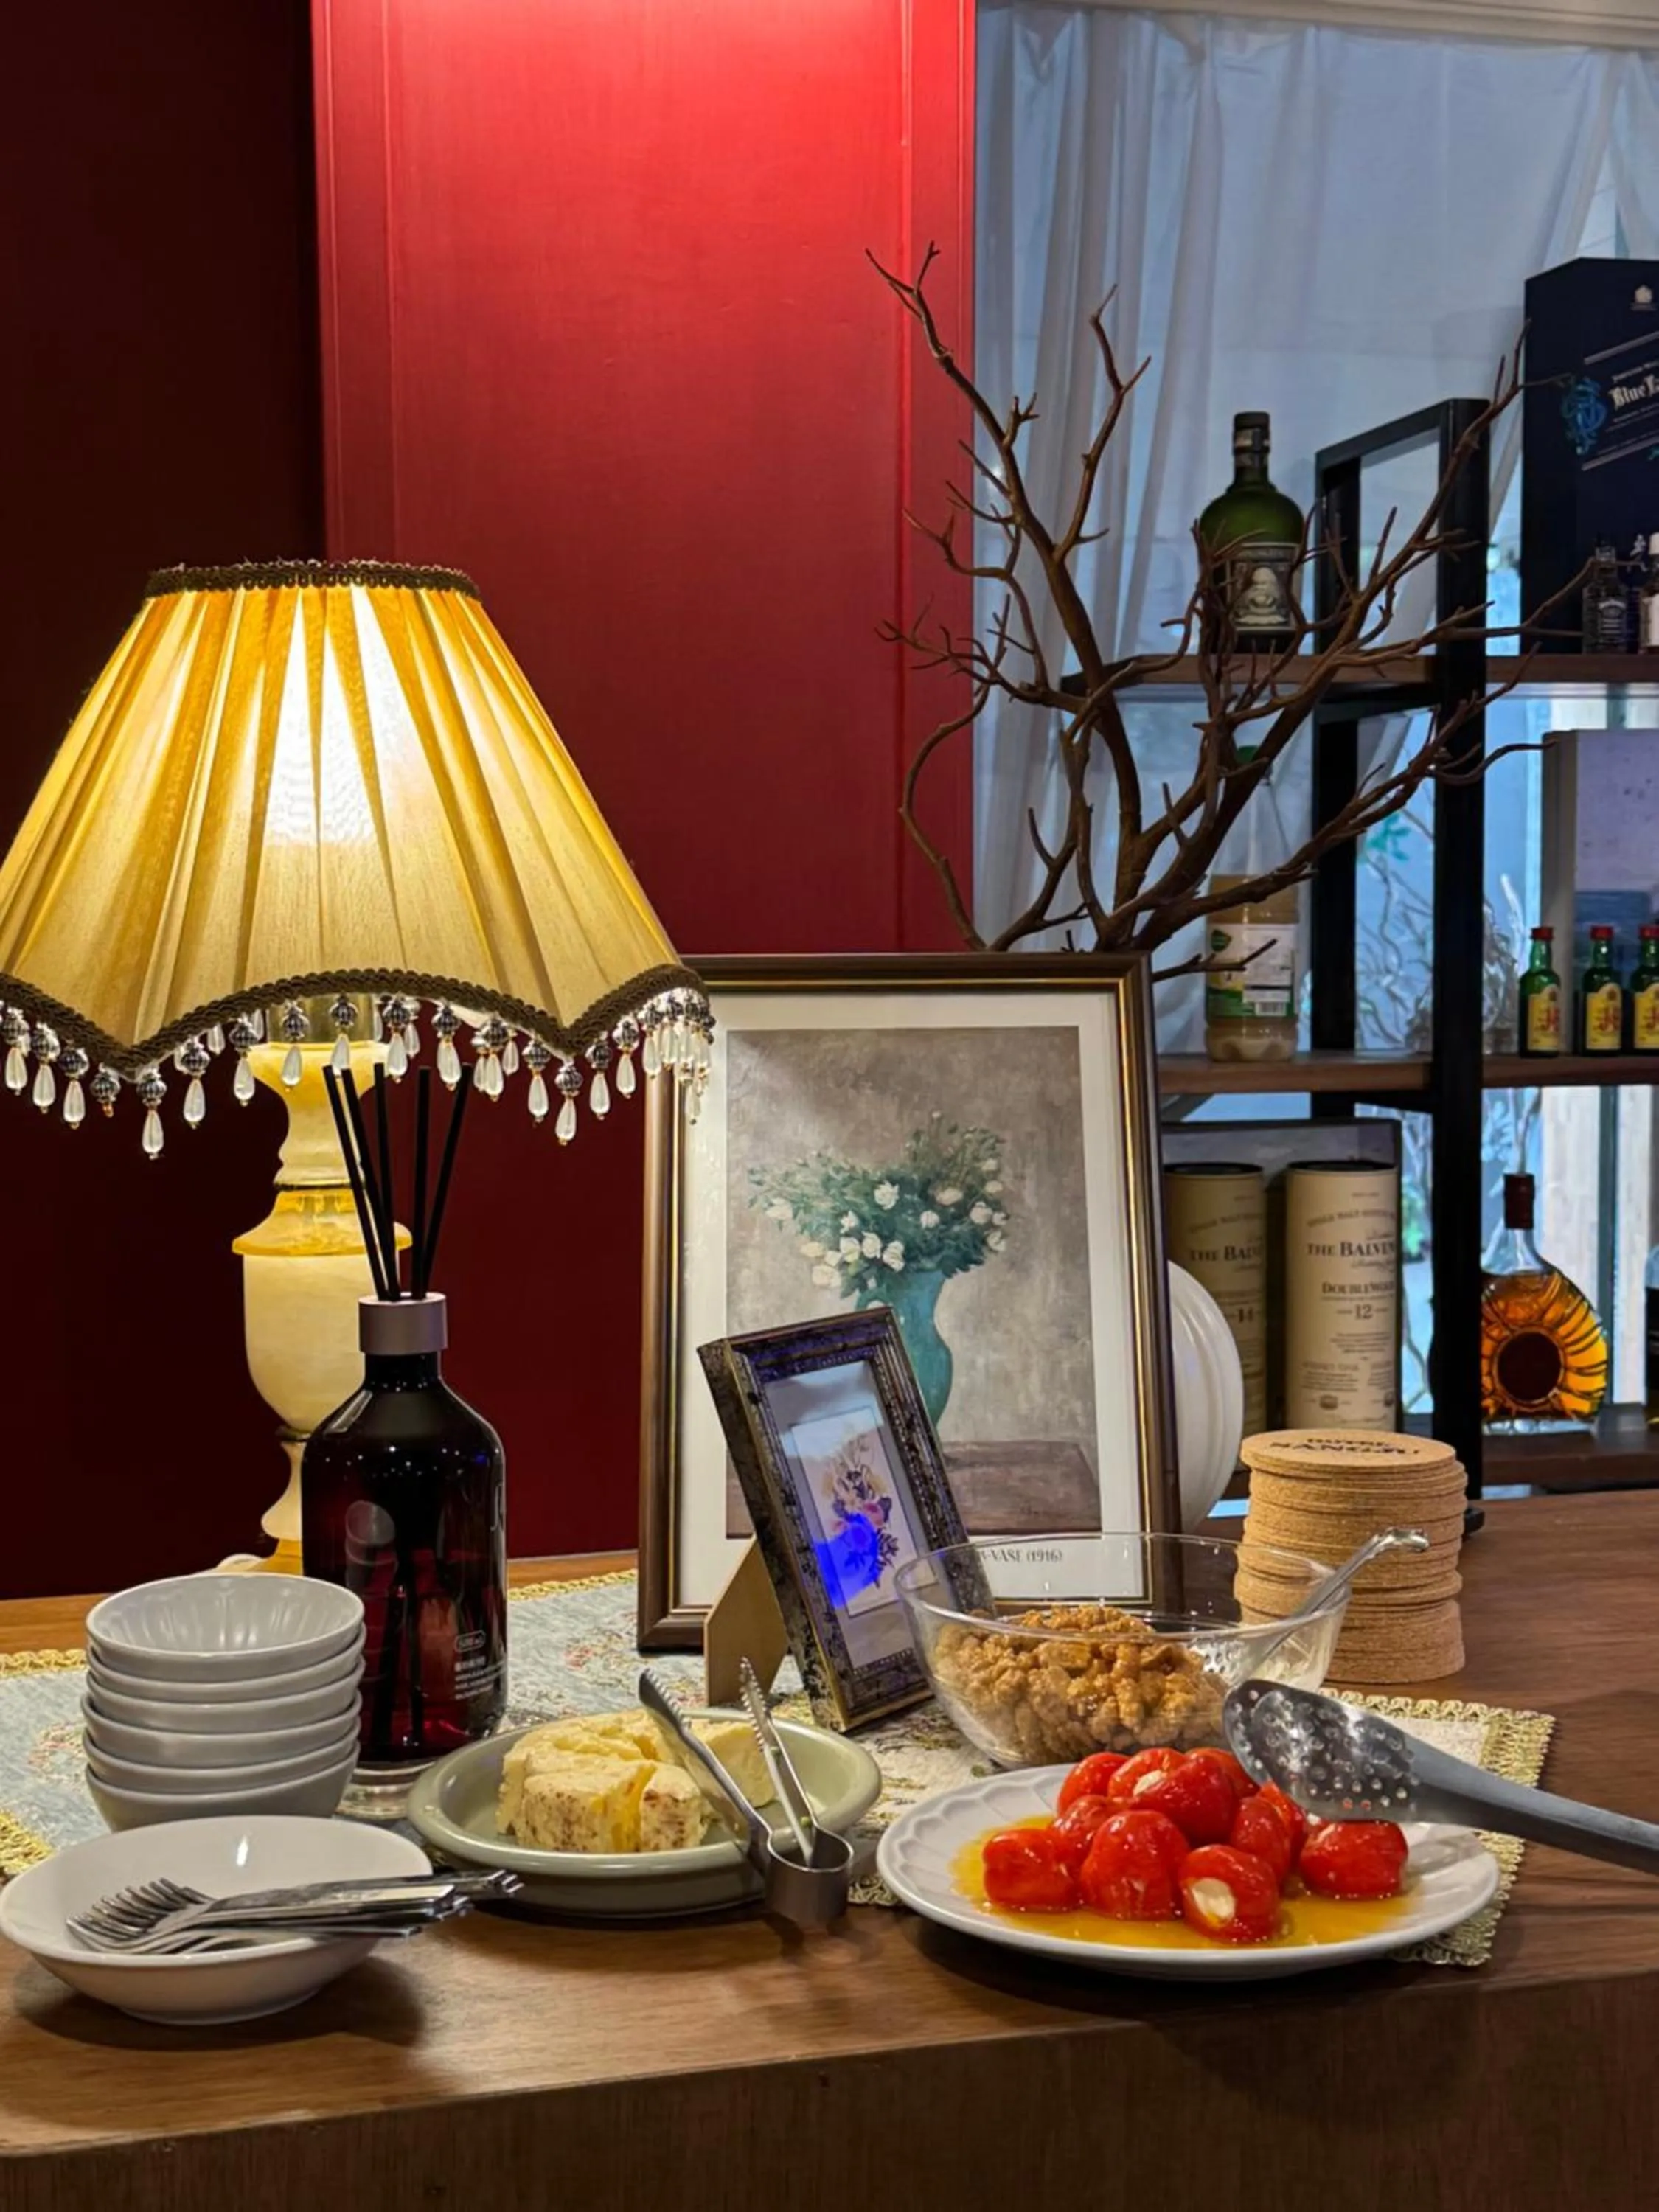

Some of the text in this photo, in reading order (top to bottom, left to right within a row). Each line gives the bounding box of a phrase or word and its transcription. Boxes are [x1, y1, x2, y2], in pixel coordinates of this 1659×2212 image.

[1608, 386, 1645, 411] Blue
[1307, 1242, 1335, 1256] THE
[1355, 1304, 1374, 1320] 12
[1026, 1549, 1063, 1562] (1916)
